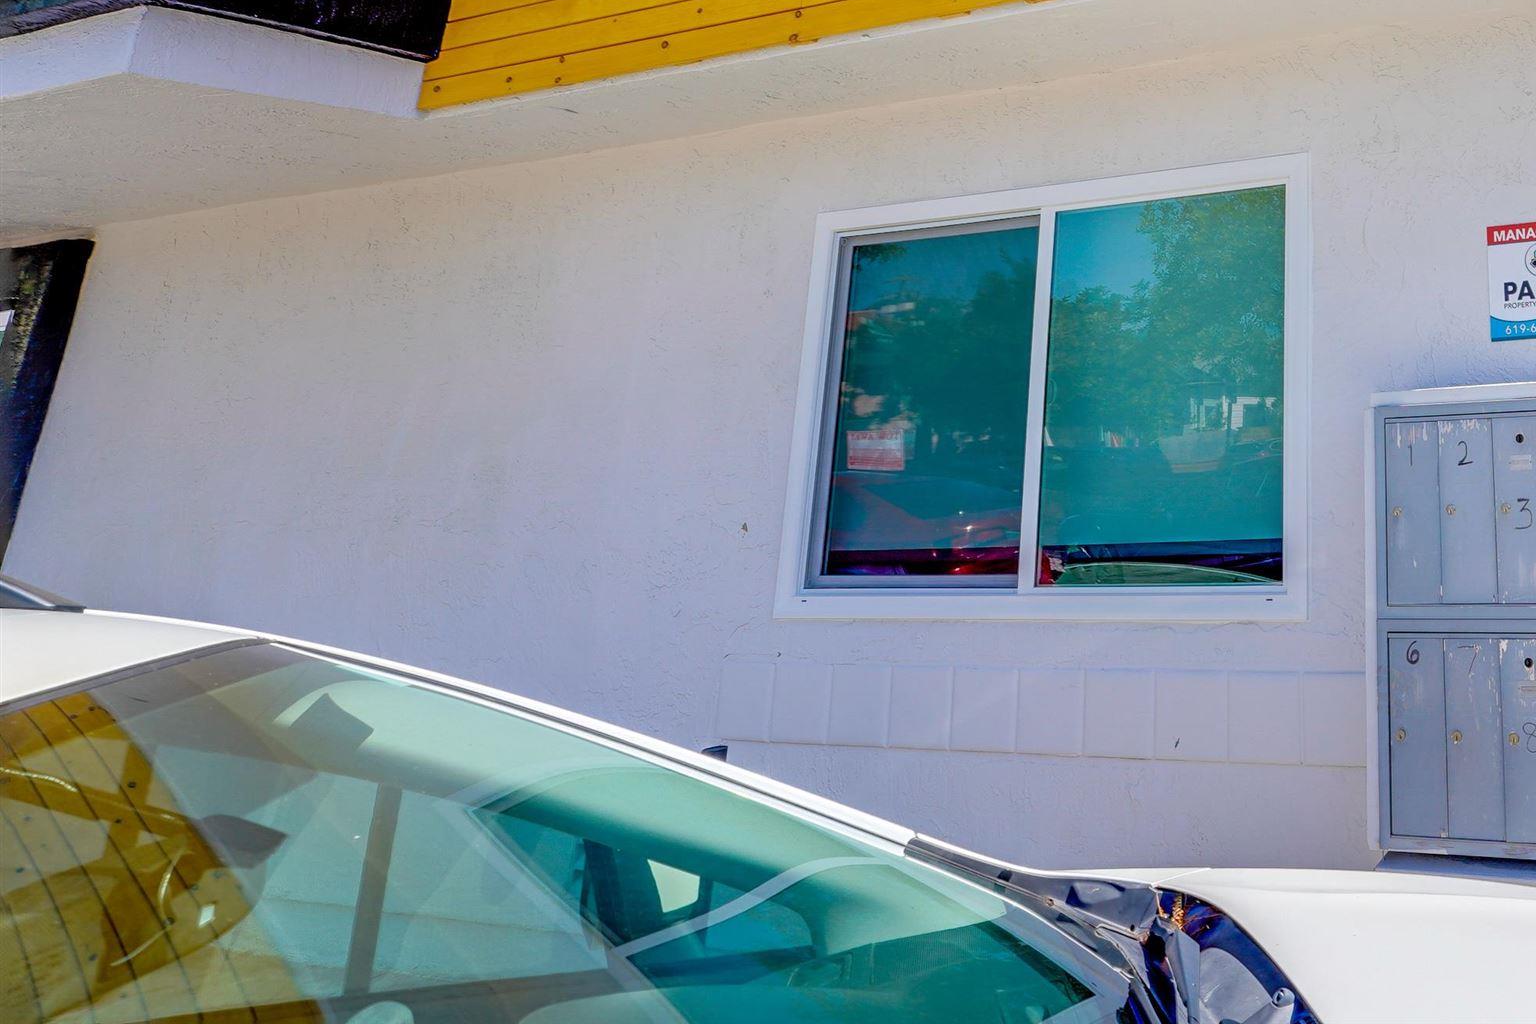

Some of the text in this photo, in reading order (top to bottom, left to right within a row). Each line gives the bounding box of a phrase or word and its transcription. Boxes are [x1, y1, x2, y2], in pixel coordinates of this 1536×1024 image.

[1504, 301, 1536, 309] PROPERTY
[1406, 445, 1414, 467] 1
[1457, 440, 1473, 466] 2
[1514, 497, 1533, 530] 3
[1406, 640, 1420, 665] 6
[1457, 644, 1480, 676] 7
